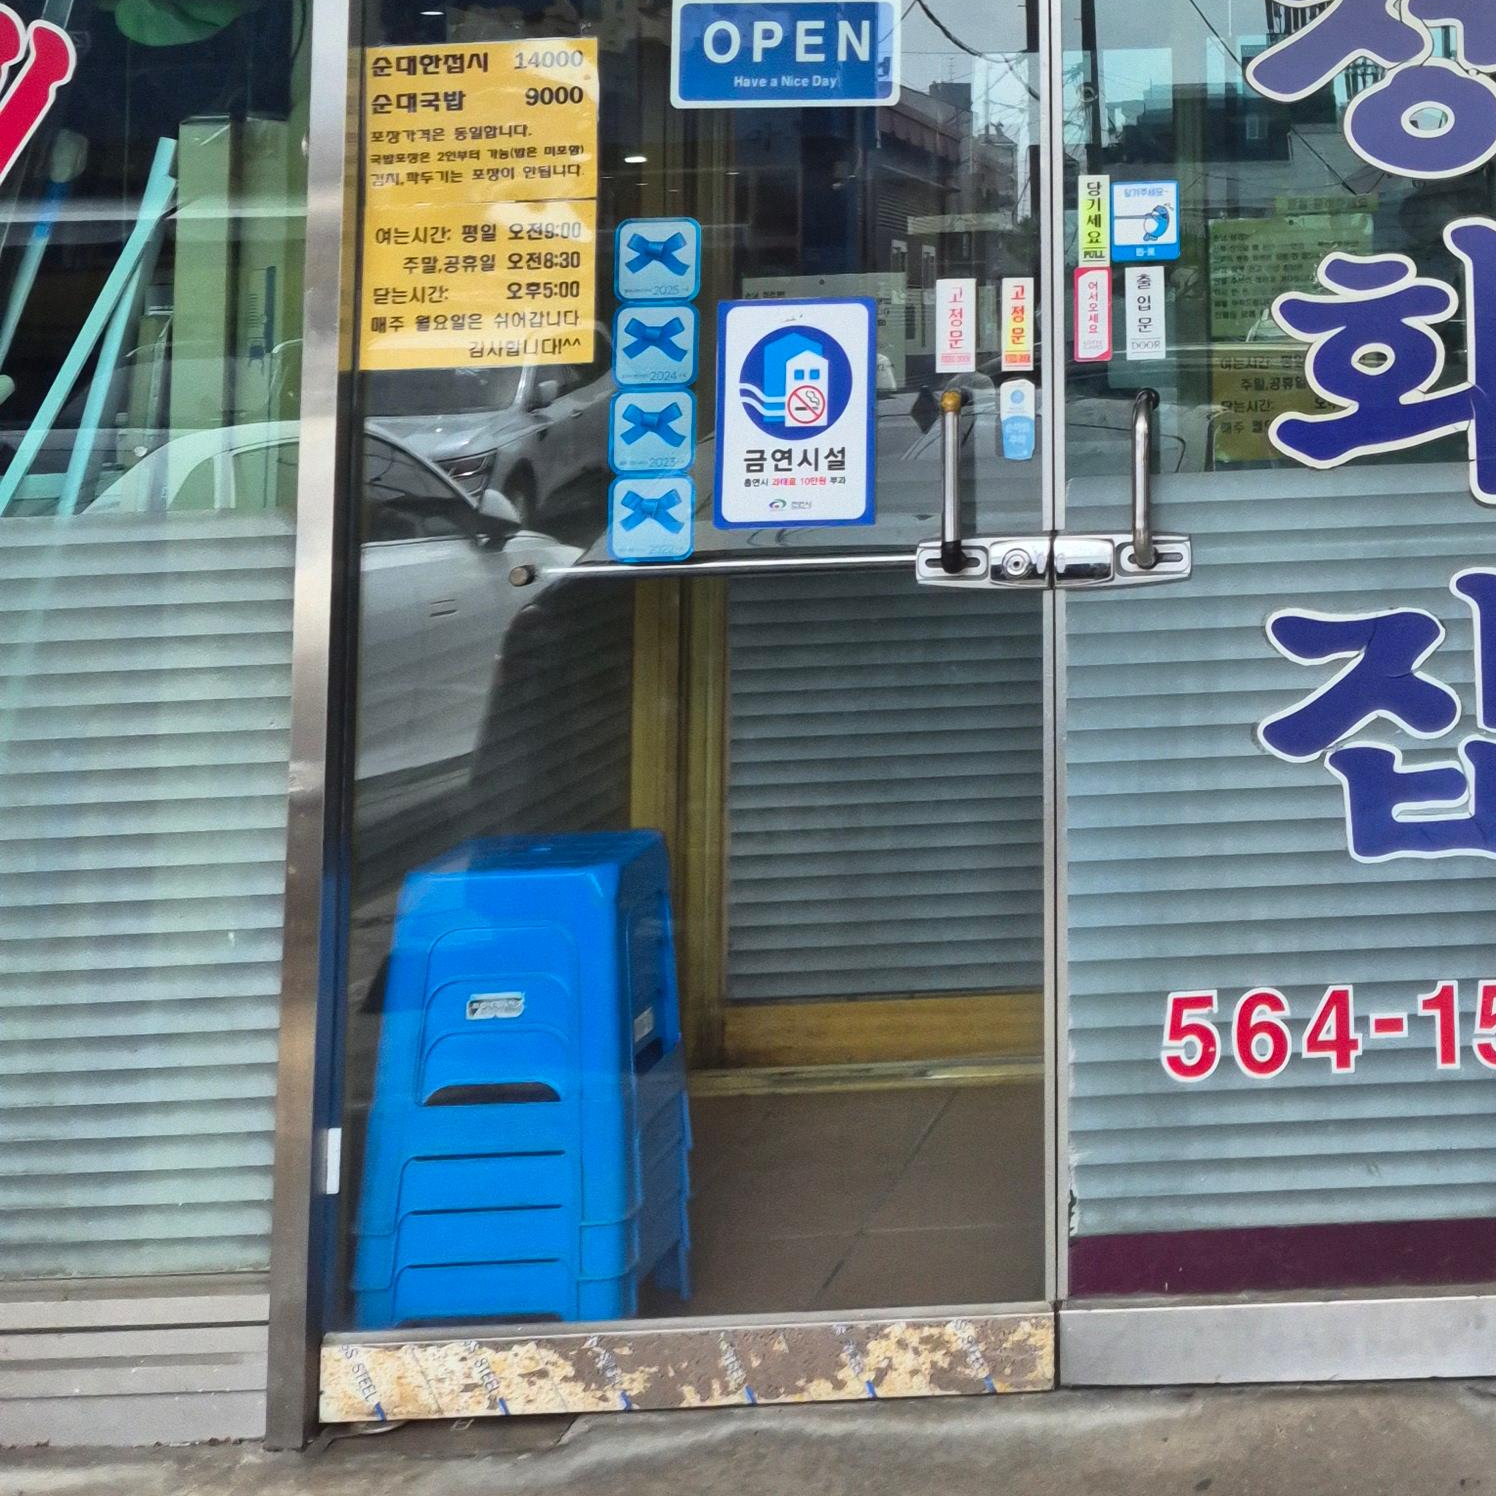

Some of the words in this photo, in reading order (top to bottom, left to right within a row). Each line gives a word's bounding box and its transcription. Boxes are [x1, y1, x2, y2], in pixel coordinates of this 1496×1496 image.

[703, 20, 870, 64] OPEN
[371, 52, 489, 77] 순대한접시
[514, 50, 584, 70] 14000
[734, 76, 767, 88] Have
[769, 79, 778, 87] a
[781, 75, 809, 87] Nice
[812, 75, 838, 88] Day
[371, 91, 466, 114] 순대국밥
[525, 86, 584, 106] 9000
[370, 127, 445, 143] 포장가격은
[454, 123, 532, 141] 동일합니다.
[437, 149, 480, 161] 2인부터
[472, 166, 515, 181] 포장이
[1086, 181, 1103, 244] 당기세요
[375, 226, 451, 245] 여는시간:
[461, 224, 497, 242] 평일
[508, 222, 582, 240] 오전9:00
[403, 255, 496, 274] 주말,공휴일
[507, 251, 581, 270] 오전8:30
[373, 286, 449, 304] 닫는시간:
[506, 280, 580, 299] 오후5:00
[1137, 274, 1153, 333] 출입문
[948, 286, 963, 349] 고정문
[1010, 284, 1026, 345] 고정문
[1088, 281, 1099, 334] 어서오세요
[371, 315, 404, 333] 매주
[416, 313, 482, 331] 월요일은
[1132, 340, 1160, 350] DOOR
[650, 371, 678, 381] 2024
[744, 446, 846, 473] 금연시설
[829, 476, 846, 485] 부과
[351, 1362, 377, 1402] STEEL
